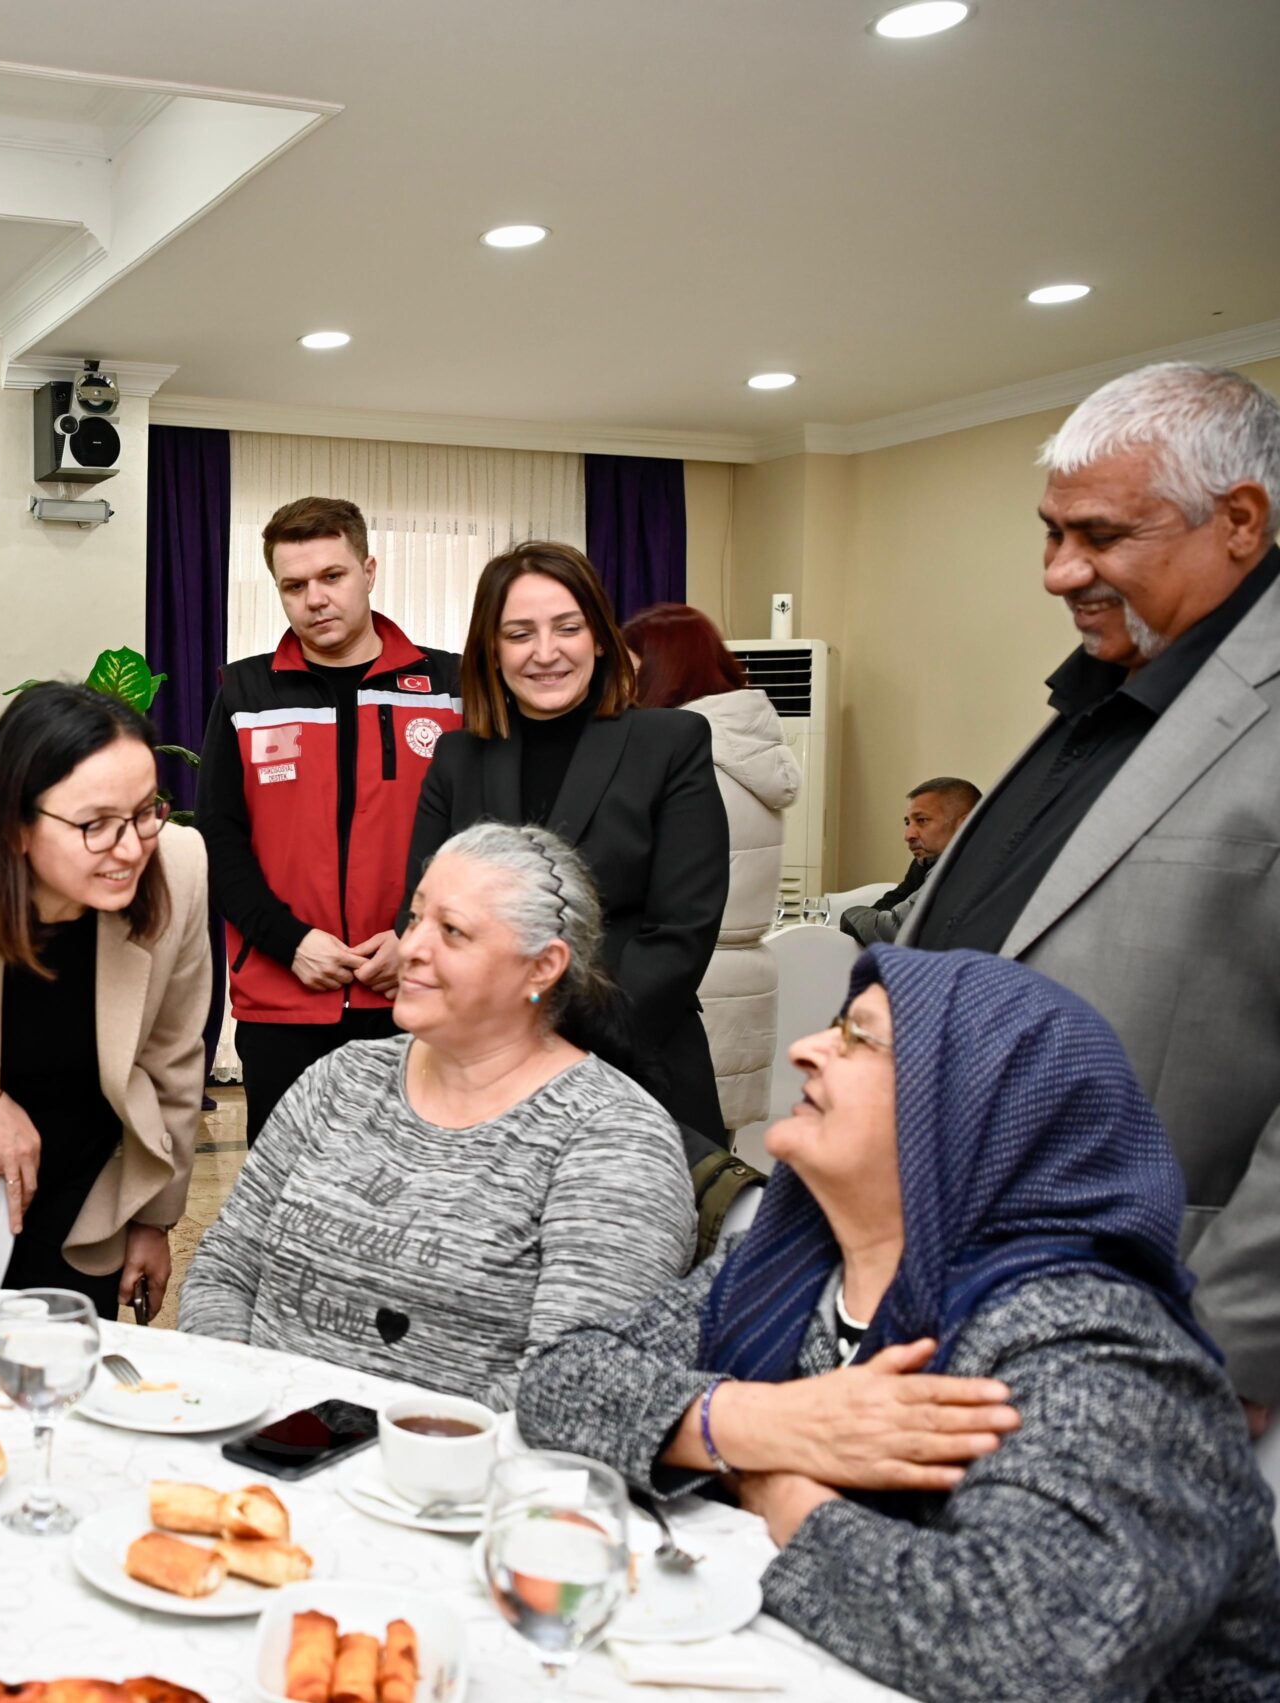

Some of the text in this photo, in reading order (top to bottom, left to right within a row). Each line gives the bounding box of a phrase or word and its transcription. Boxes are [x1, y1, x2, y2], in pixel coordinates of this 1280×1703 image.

[266, 1200, 445, 1268] you need is
